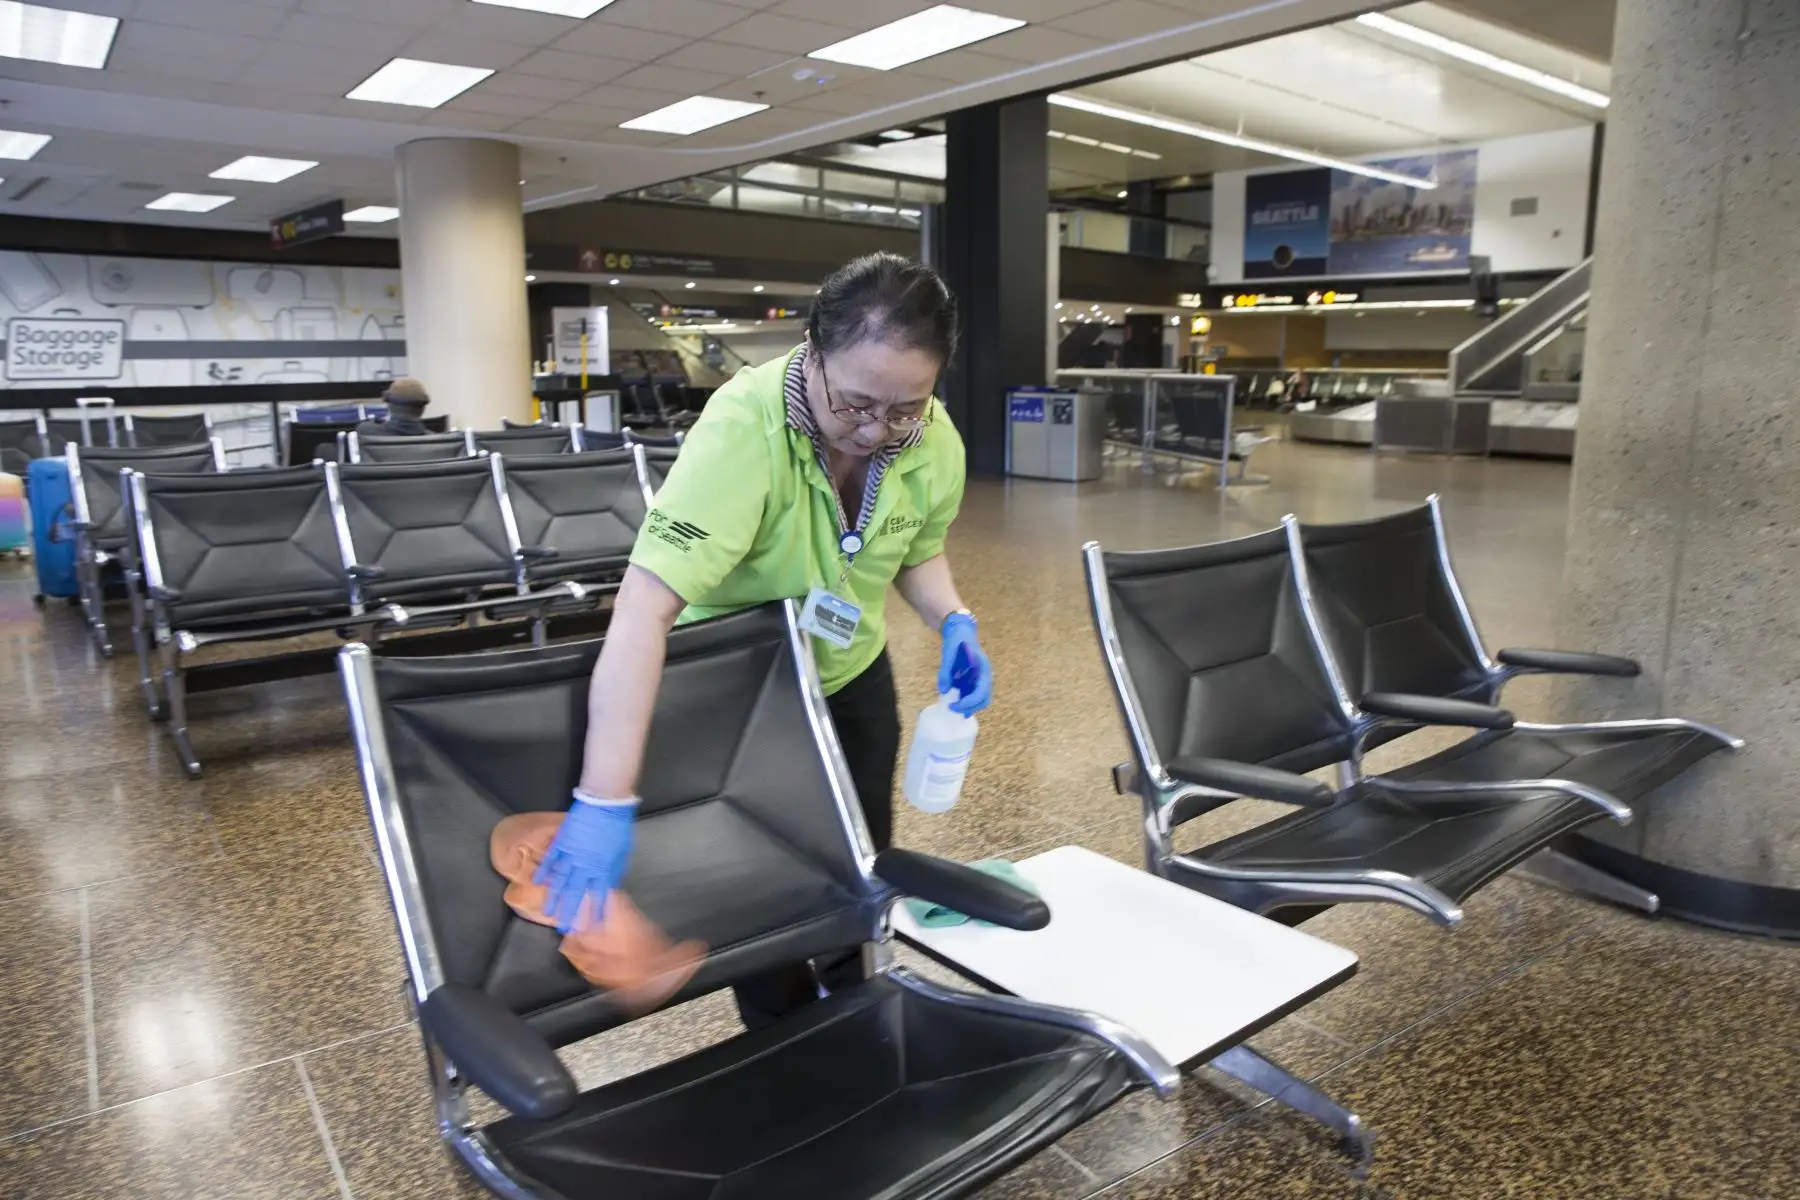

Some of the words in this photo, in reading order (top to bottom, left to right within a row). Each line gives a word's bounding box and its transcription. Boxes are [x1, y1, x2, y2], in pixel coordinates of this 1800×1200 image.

[1252, 205, 1319, 225] SEATTLE
[15, 325, 119, 349] Baggage
[14, 346, 103, 370] Storage
[648, 508, 669, 522] Por
